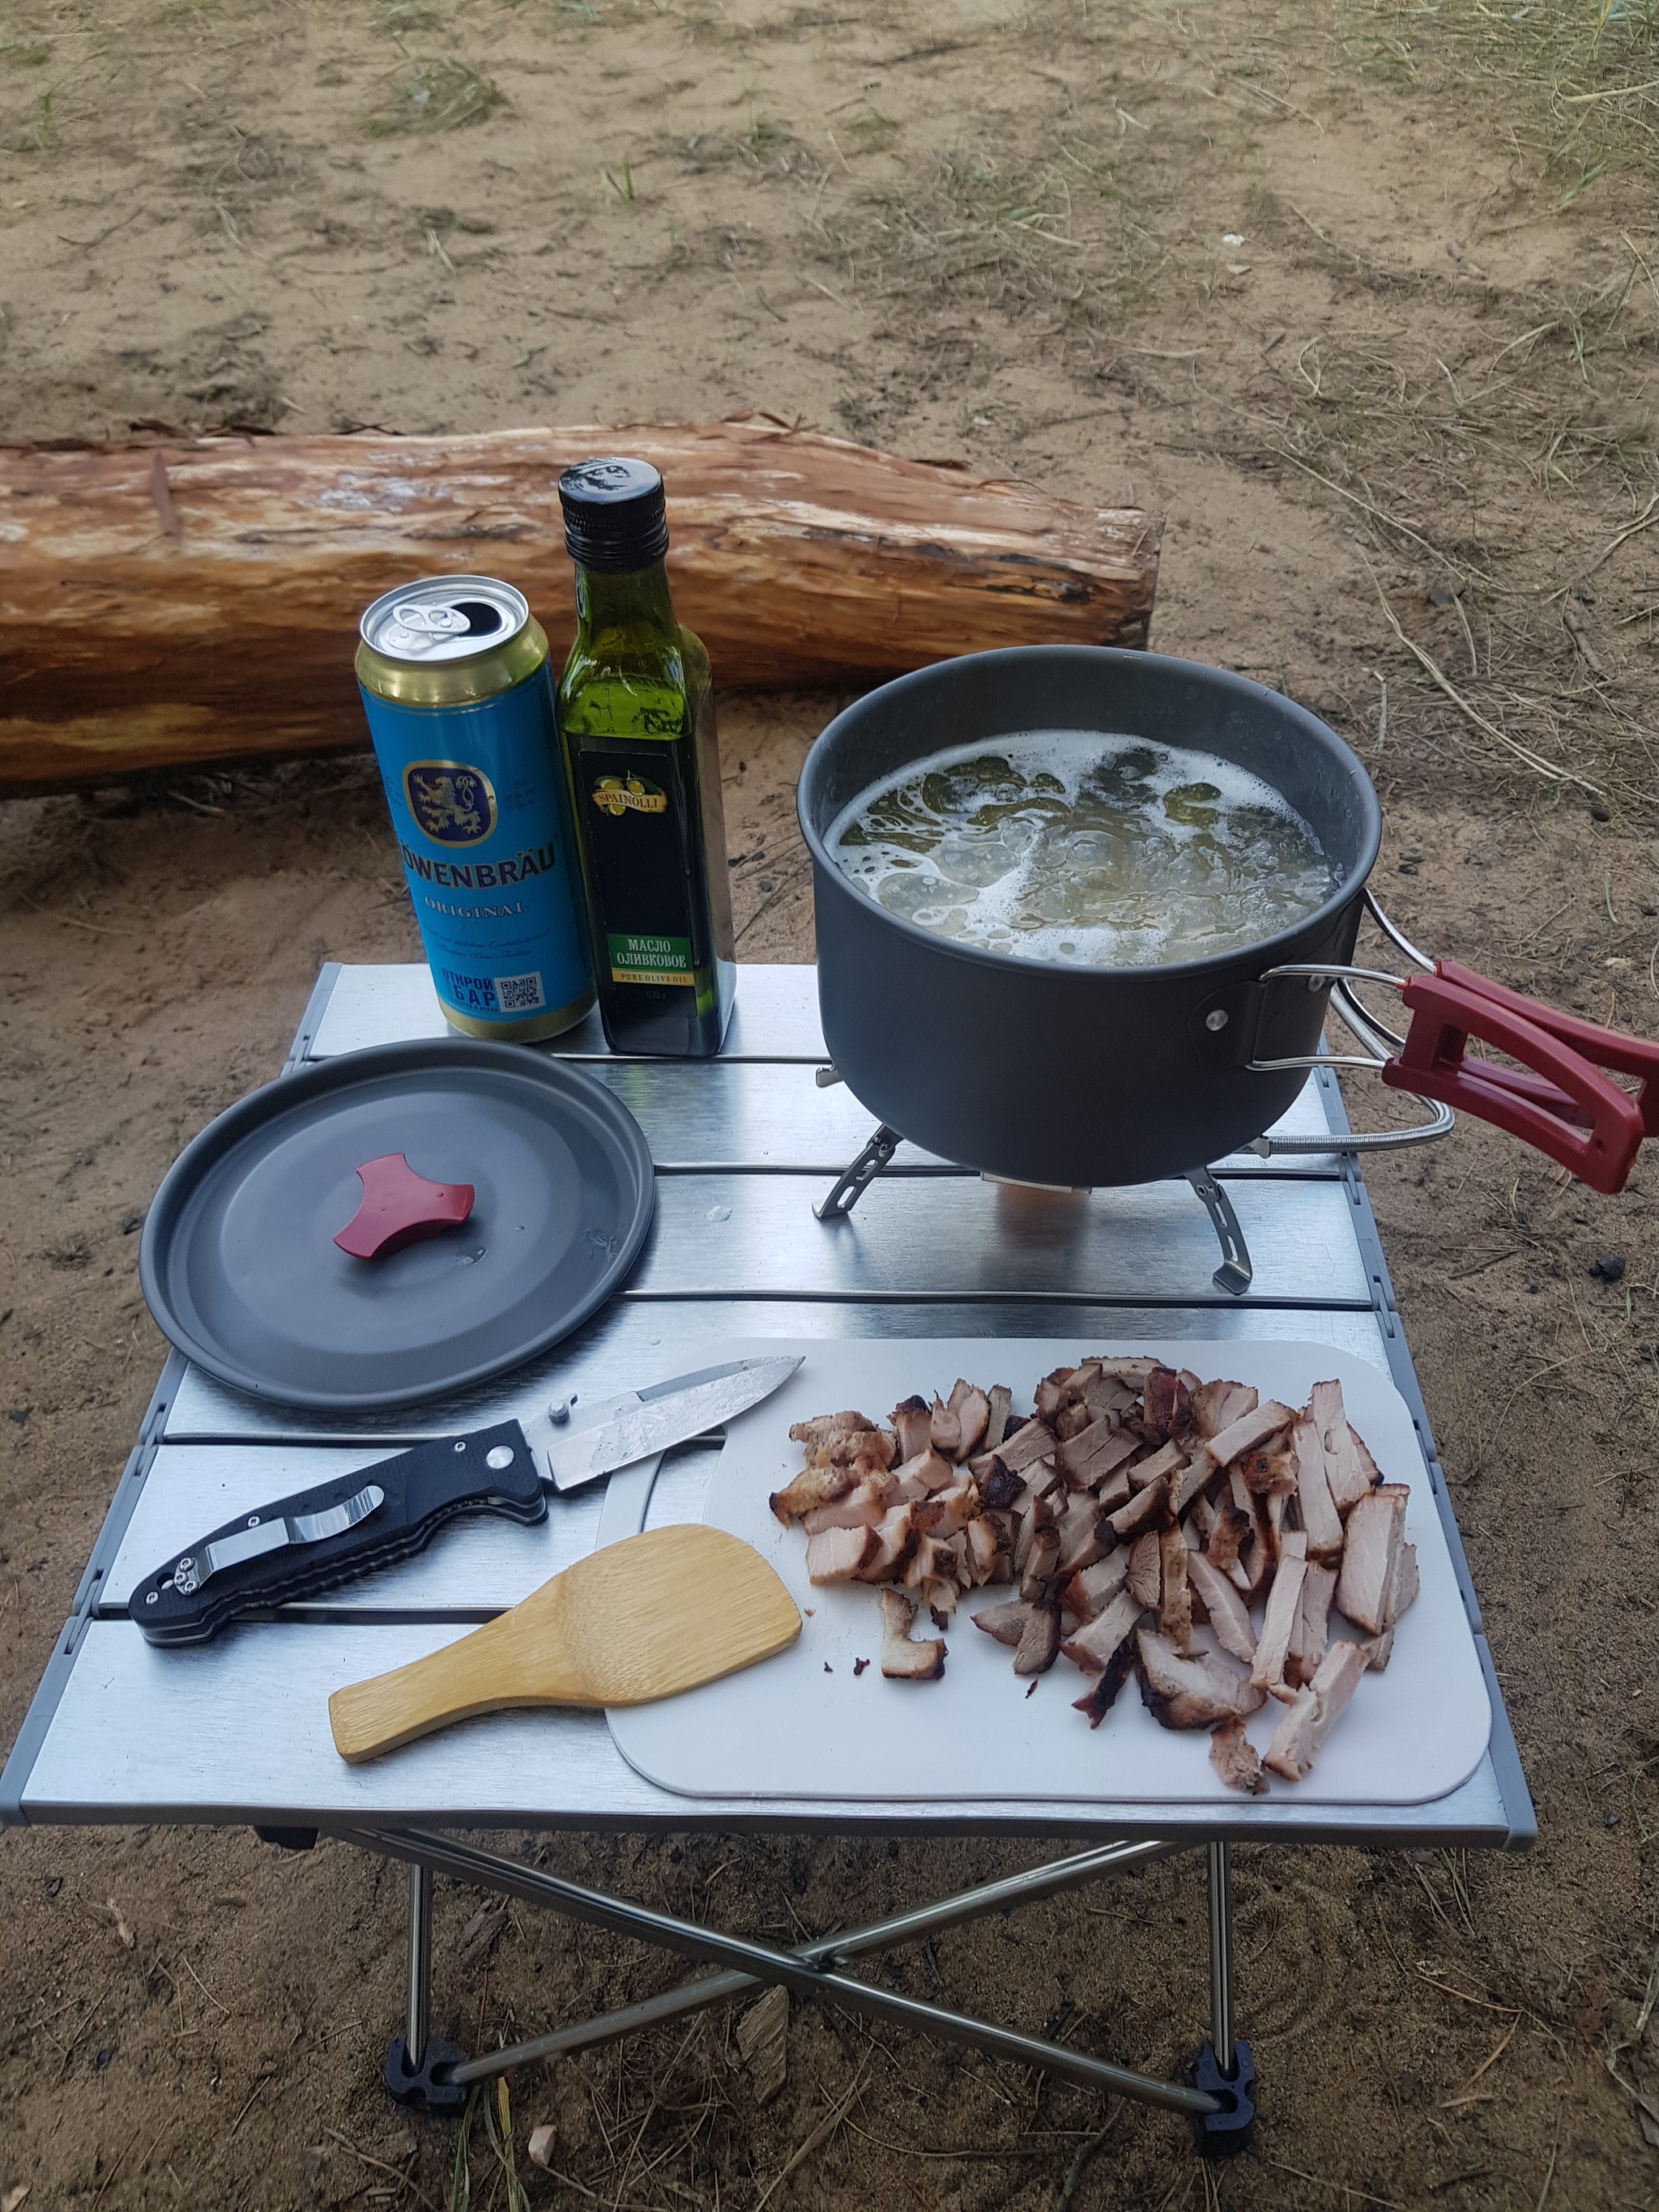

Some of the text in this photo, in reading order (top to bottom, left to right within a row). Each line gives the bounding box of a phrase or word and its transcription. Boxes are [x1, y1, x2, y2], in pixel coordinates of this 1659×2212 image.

[599, 794, 658, 808] SPAINOLLI
[401, 837, 557, 889] ÖWENBRÄU
[424, 896, 529, 919] ORIGINAL
[627, 938, 672, 953] МАСЛО
[616, 952, 687, 969] ОЛИВКОВОЕ
[441, 966, 494, 991] ОТКРОЙ
[645, 974, 672, 982] OLIVE
[454, 983, 497, 1007] БАР
